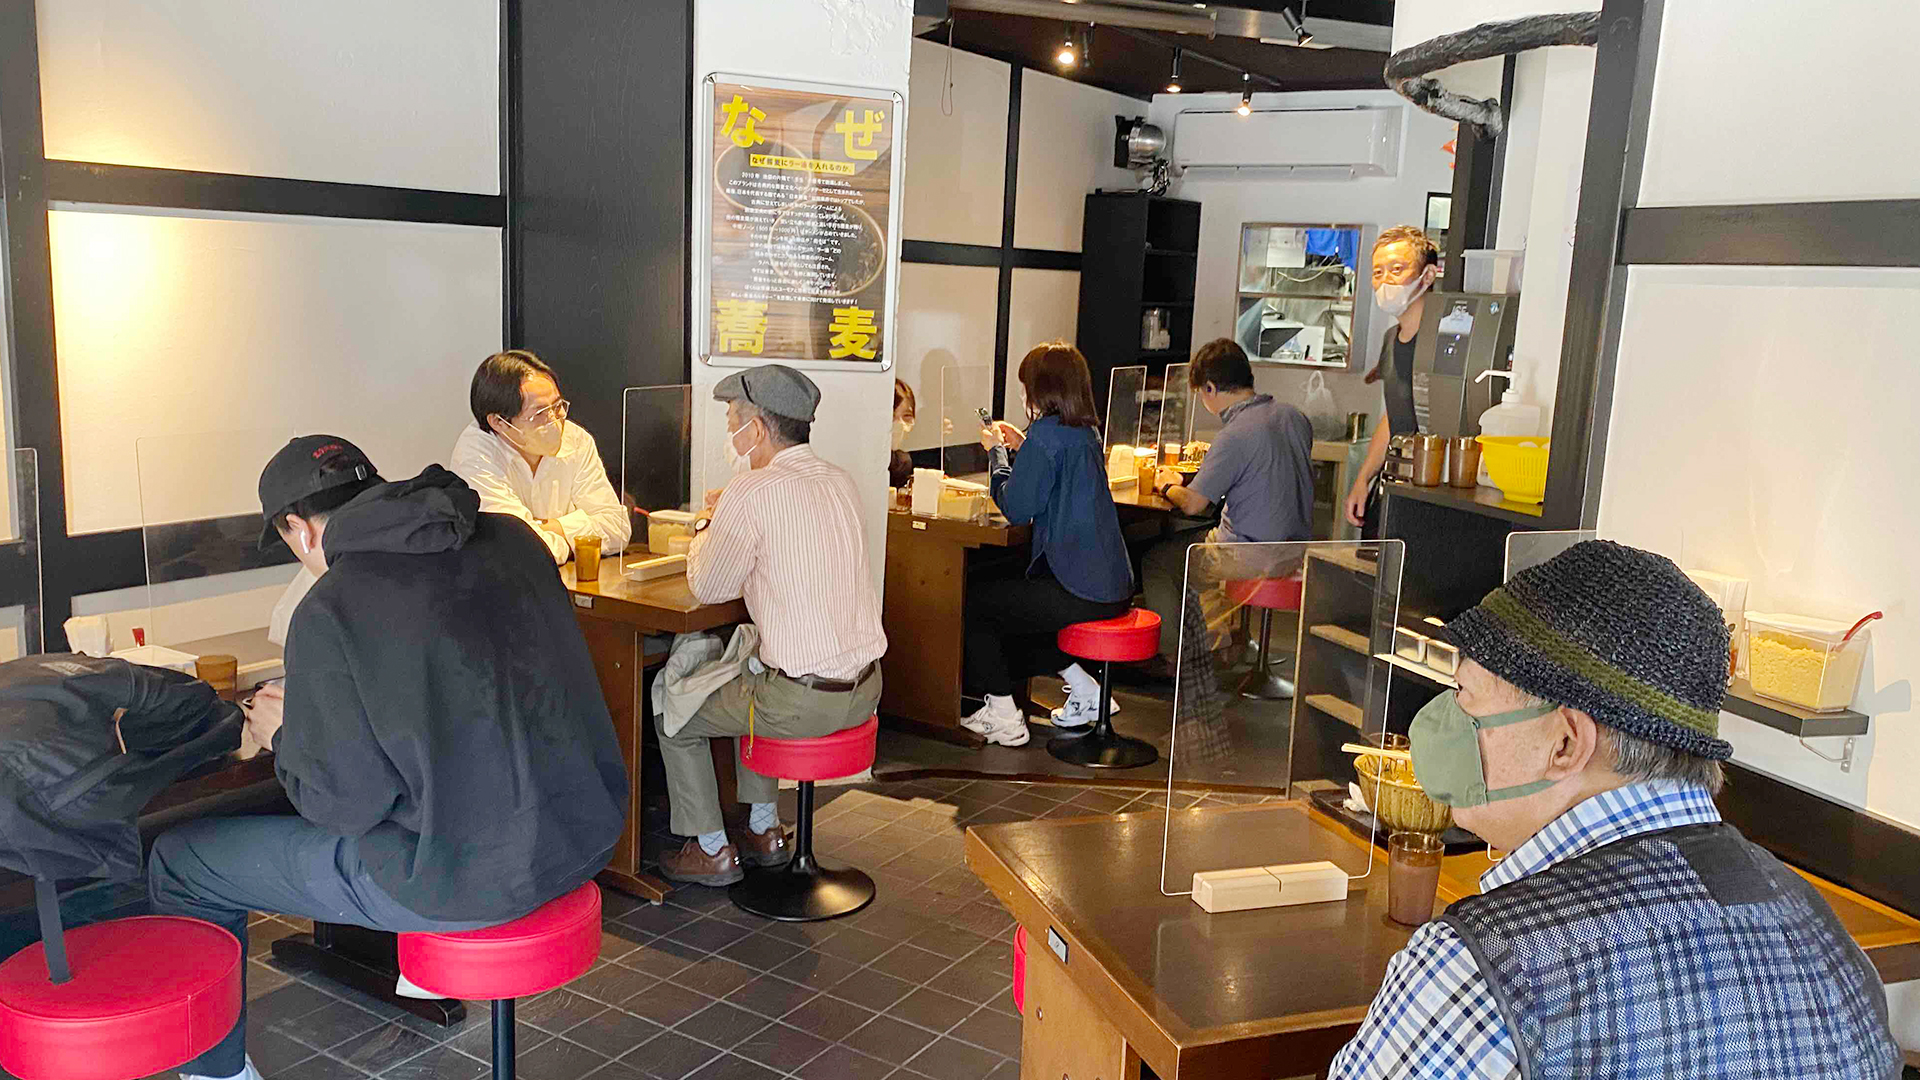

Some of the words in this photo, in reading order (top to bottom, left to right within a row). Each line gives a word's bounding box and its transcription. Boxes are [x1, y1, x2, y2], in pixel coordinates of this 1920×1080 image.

[720, 94, 766, 148] な
[835, 109, 886, 160] ぜ
[716, 299, 768, 355] 蕎
[828, 306, 878, 360] 麦
